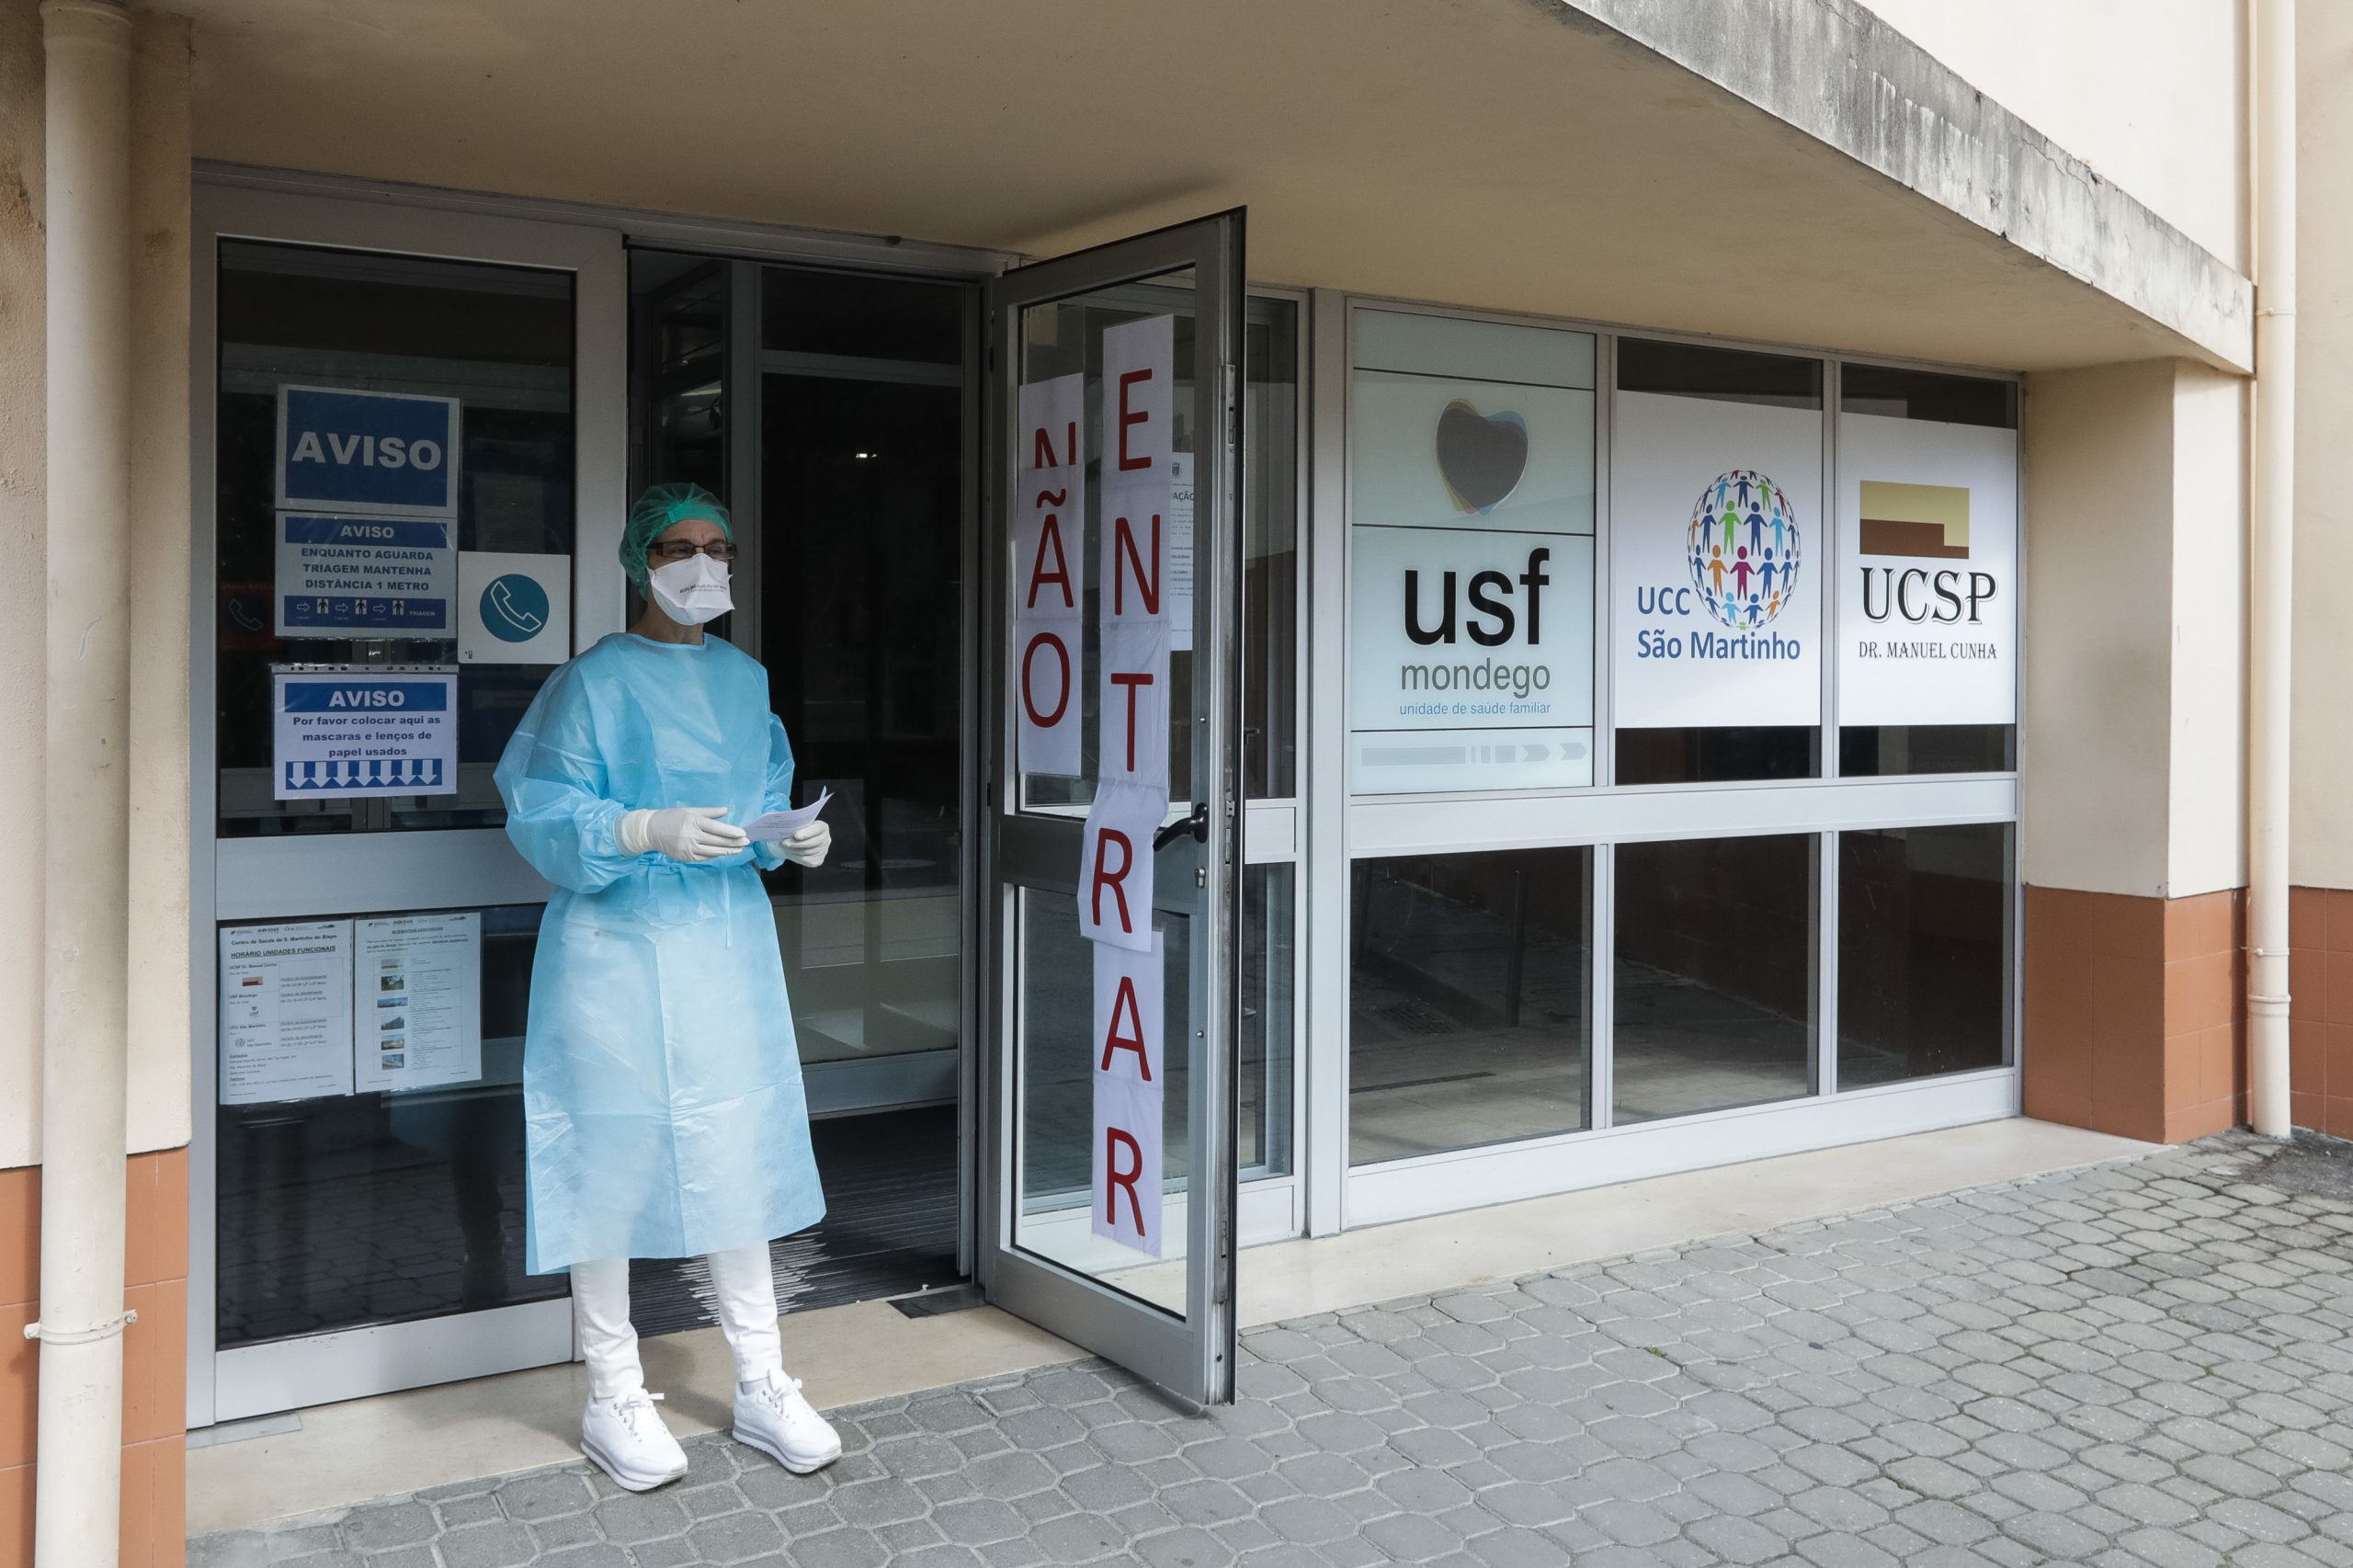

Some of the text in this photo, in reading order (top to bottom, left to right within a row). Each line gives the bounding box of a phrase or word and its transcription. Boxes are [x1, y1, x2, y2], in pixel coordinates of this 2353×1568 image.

[291, 431, 441, 471] AVISO
[340, 525, 394, 539] AVISO
[301, 548, 434, 561] ENQUANTO AGUARDA
[303, 563, 432, 575] TRIAGEM MANTENHA
[305, 579, 429, 591] DISTÂNCIA 1 METRO
[1404, 547, 1550, 647] usf
[1638, 586, 1691, 616] UCC
[1859, 567, 1999, 625] UCSP
[1637, 629, 1801, 660] São Martinho
[1859, 642, 1997, 659] DR. MANUEL CUNHA
[1401, 657, 1551, 699] mondego
[329, 690, 404, 708] AVISO
[1400, 700, 1552, 715] unidade de saúde familiar
[293, 717, 313, 726] Por
[317, 716, 347, 725] favor
[351, 716, 396, 725] colocar
[399, 715, 424, 726] aqui
[302, 733, 361, 741] mascaras
[376, 732, 415, 742] lenços
[417, 731, 432, 740] de
[328, 747, 407, 758] papel usados
[1091, 368, 1160, 1237] ENTRAR
[231, 945, 336, 958] HORÁRIO UNIDADES FUNCIONAIS
